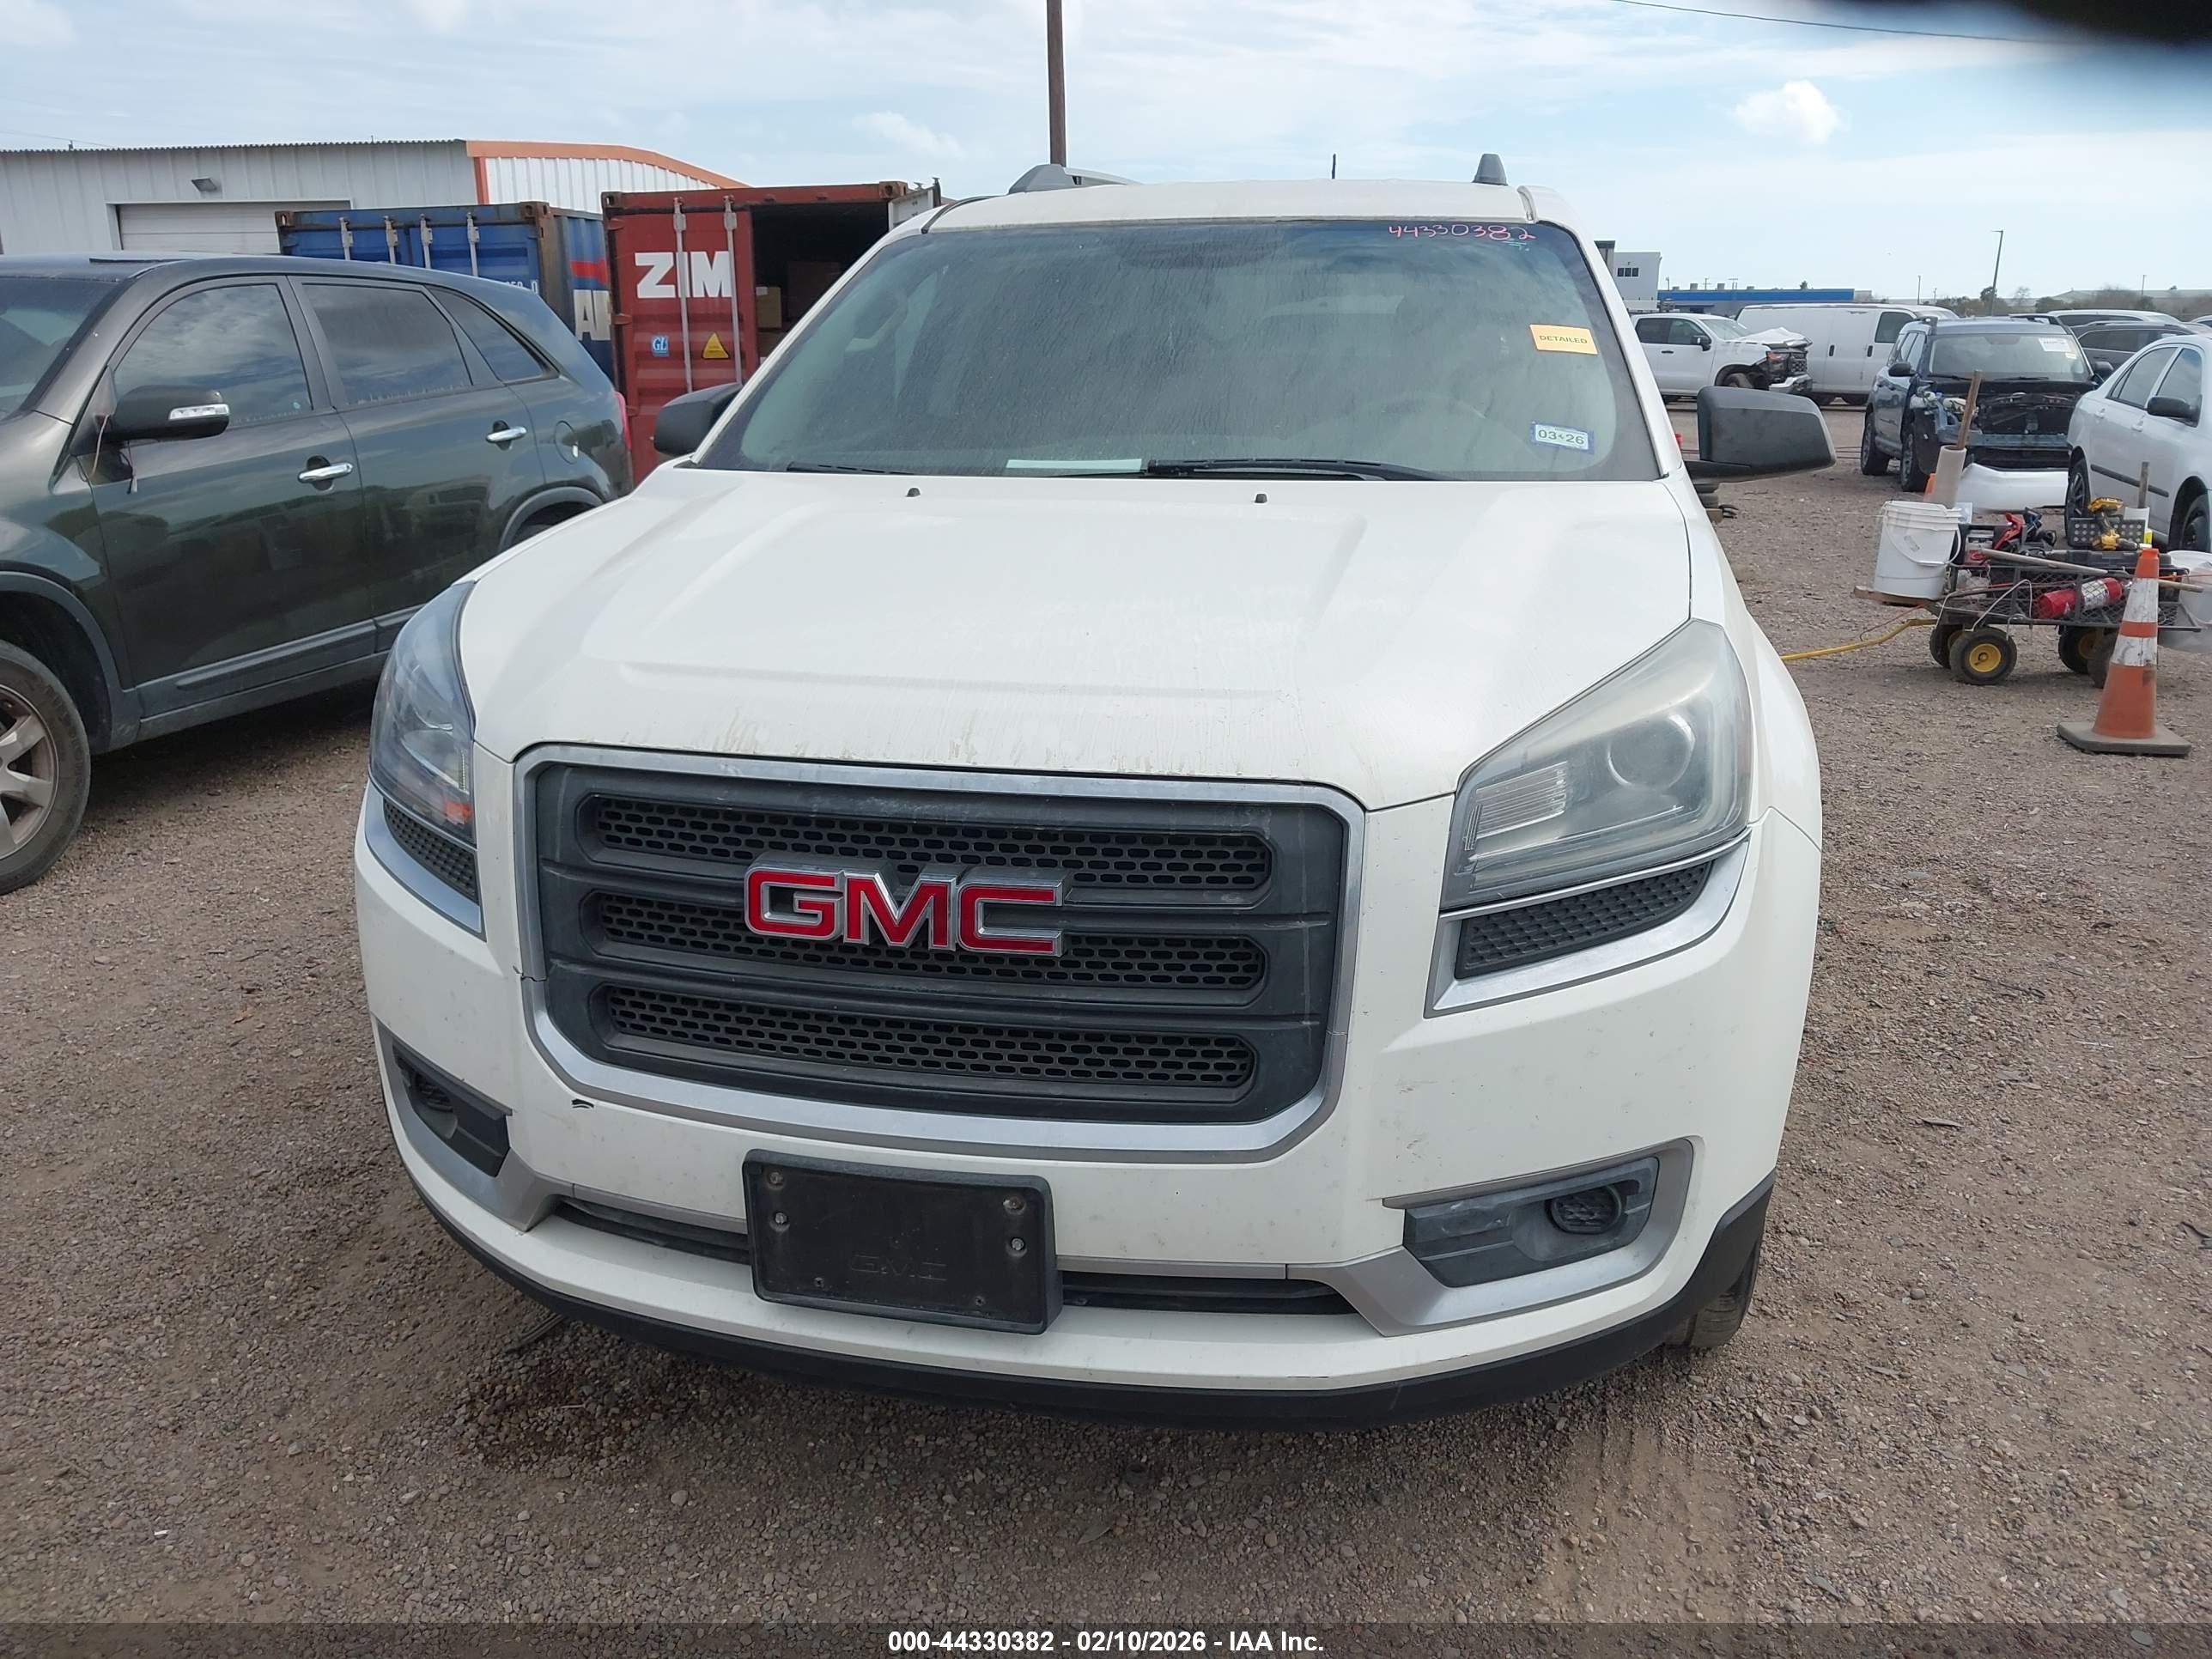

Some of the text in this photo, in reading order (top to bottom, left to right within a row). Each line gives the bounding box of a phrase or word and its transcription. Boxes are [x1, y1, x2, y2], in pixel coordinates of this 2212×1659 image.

[1388, 224, 1536, 240] 44330382
[635, 251, 732, 299] ZIM
[653, 336, 667, 352] GL
[1539, 334, 1588, 344] DETAILED
[744, 863, 1066, 957] GMC
